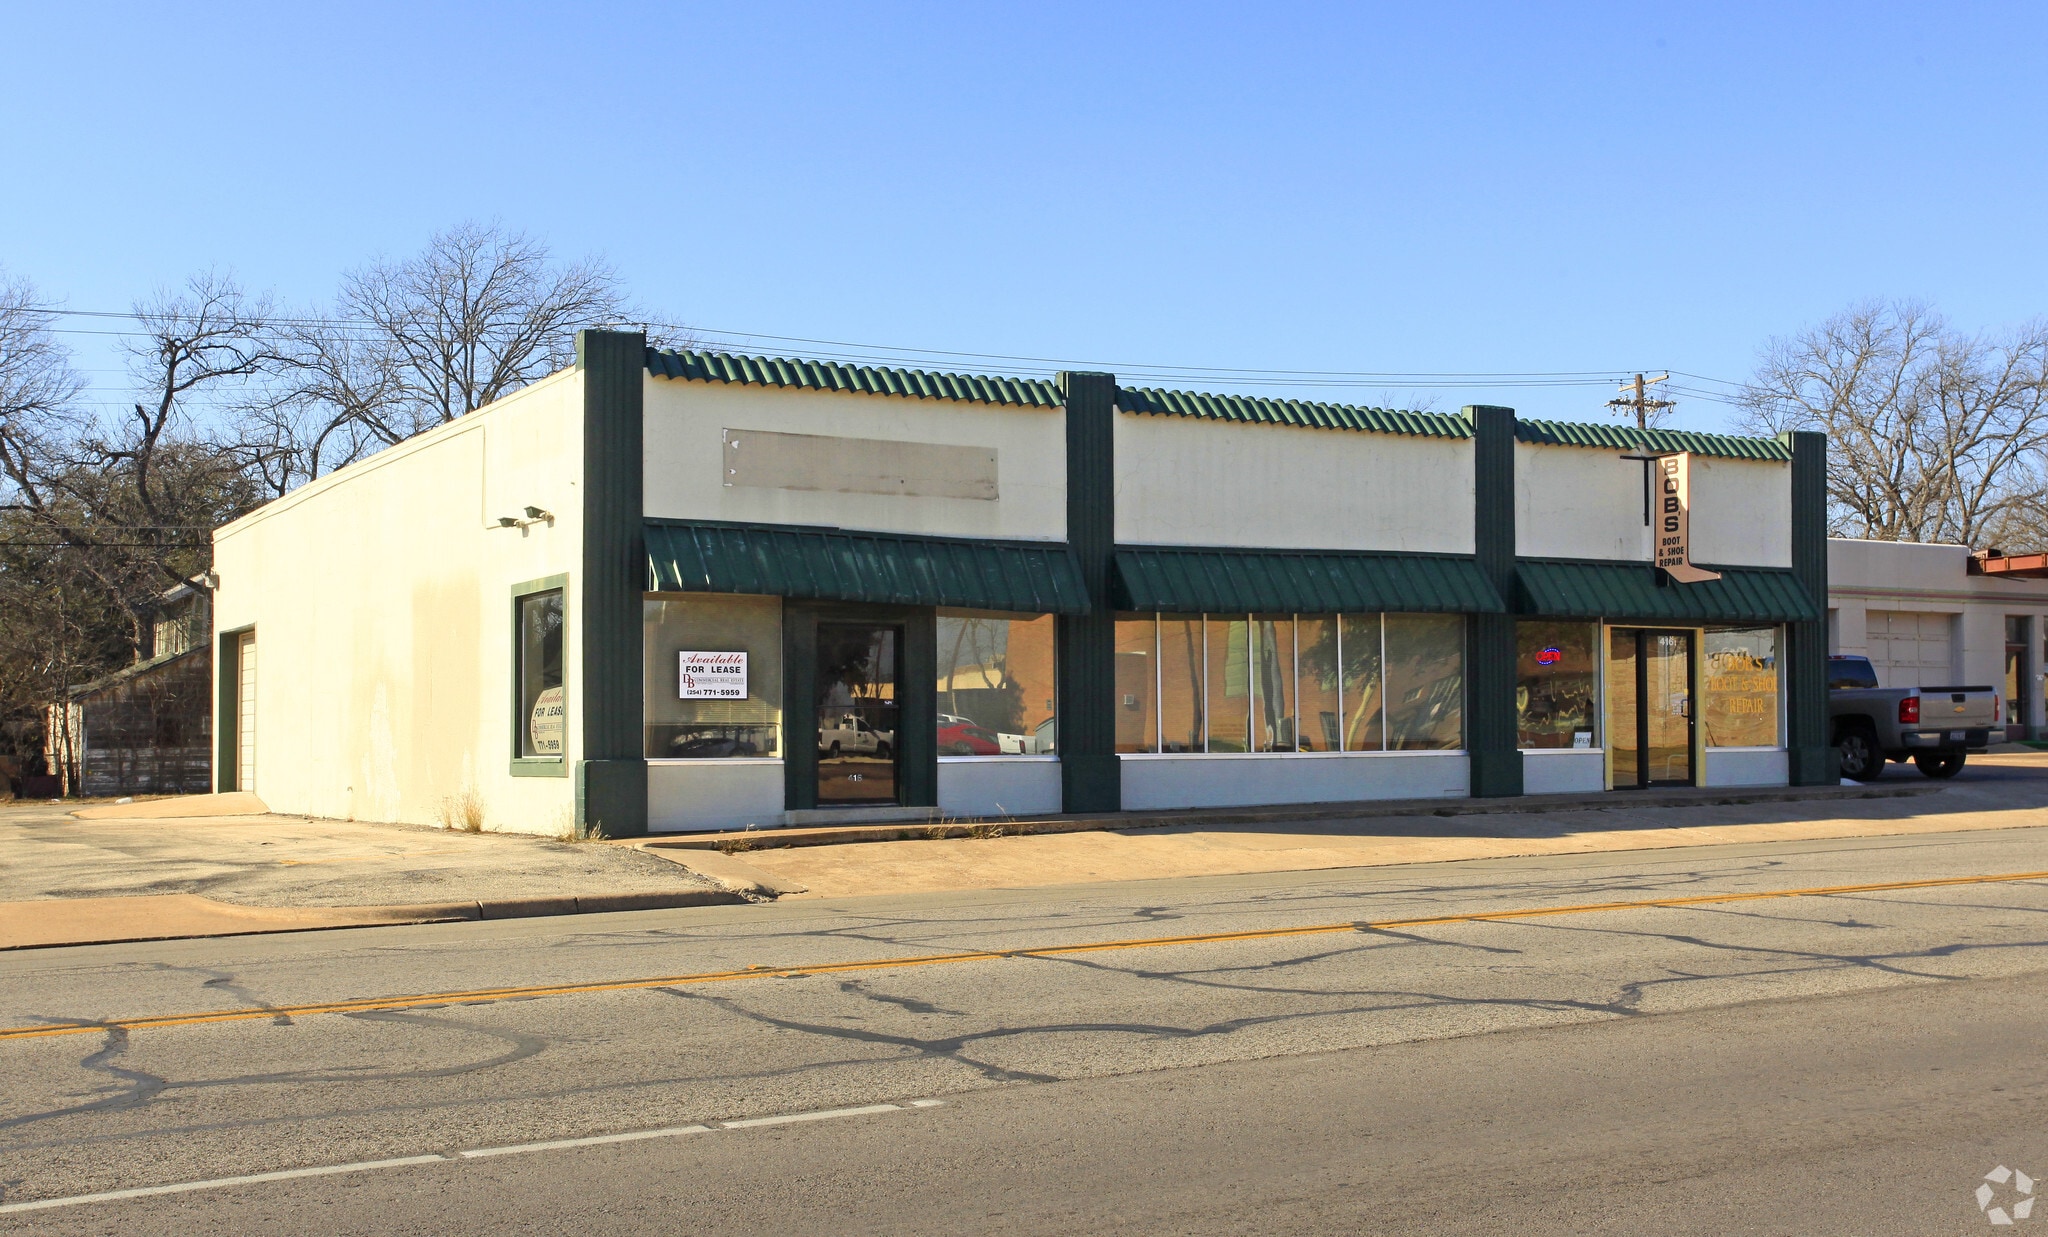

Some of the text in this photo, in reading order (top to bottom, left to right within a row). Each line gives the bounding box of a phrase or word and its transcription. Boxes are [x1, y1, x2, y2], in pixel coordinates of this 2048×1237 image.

[1662, 536, 1681, 546] BOOT
[1658, 546, 1684, 556] & SHOE
[1659, 557, 1683, 567] REPAIR
[683, 653, 743, 664] Available
[1536, 652, 1560, 661] OPEN
[686, 665, 741, 674] FOR LEASE
[1729, 698, 1764, 713] REPAIR
[535, 707, 546, 717] FOR
[537, 739, 560, 750] 771-5959
